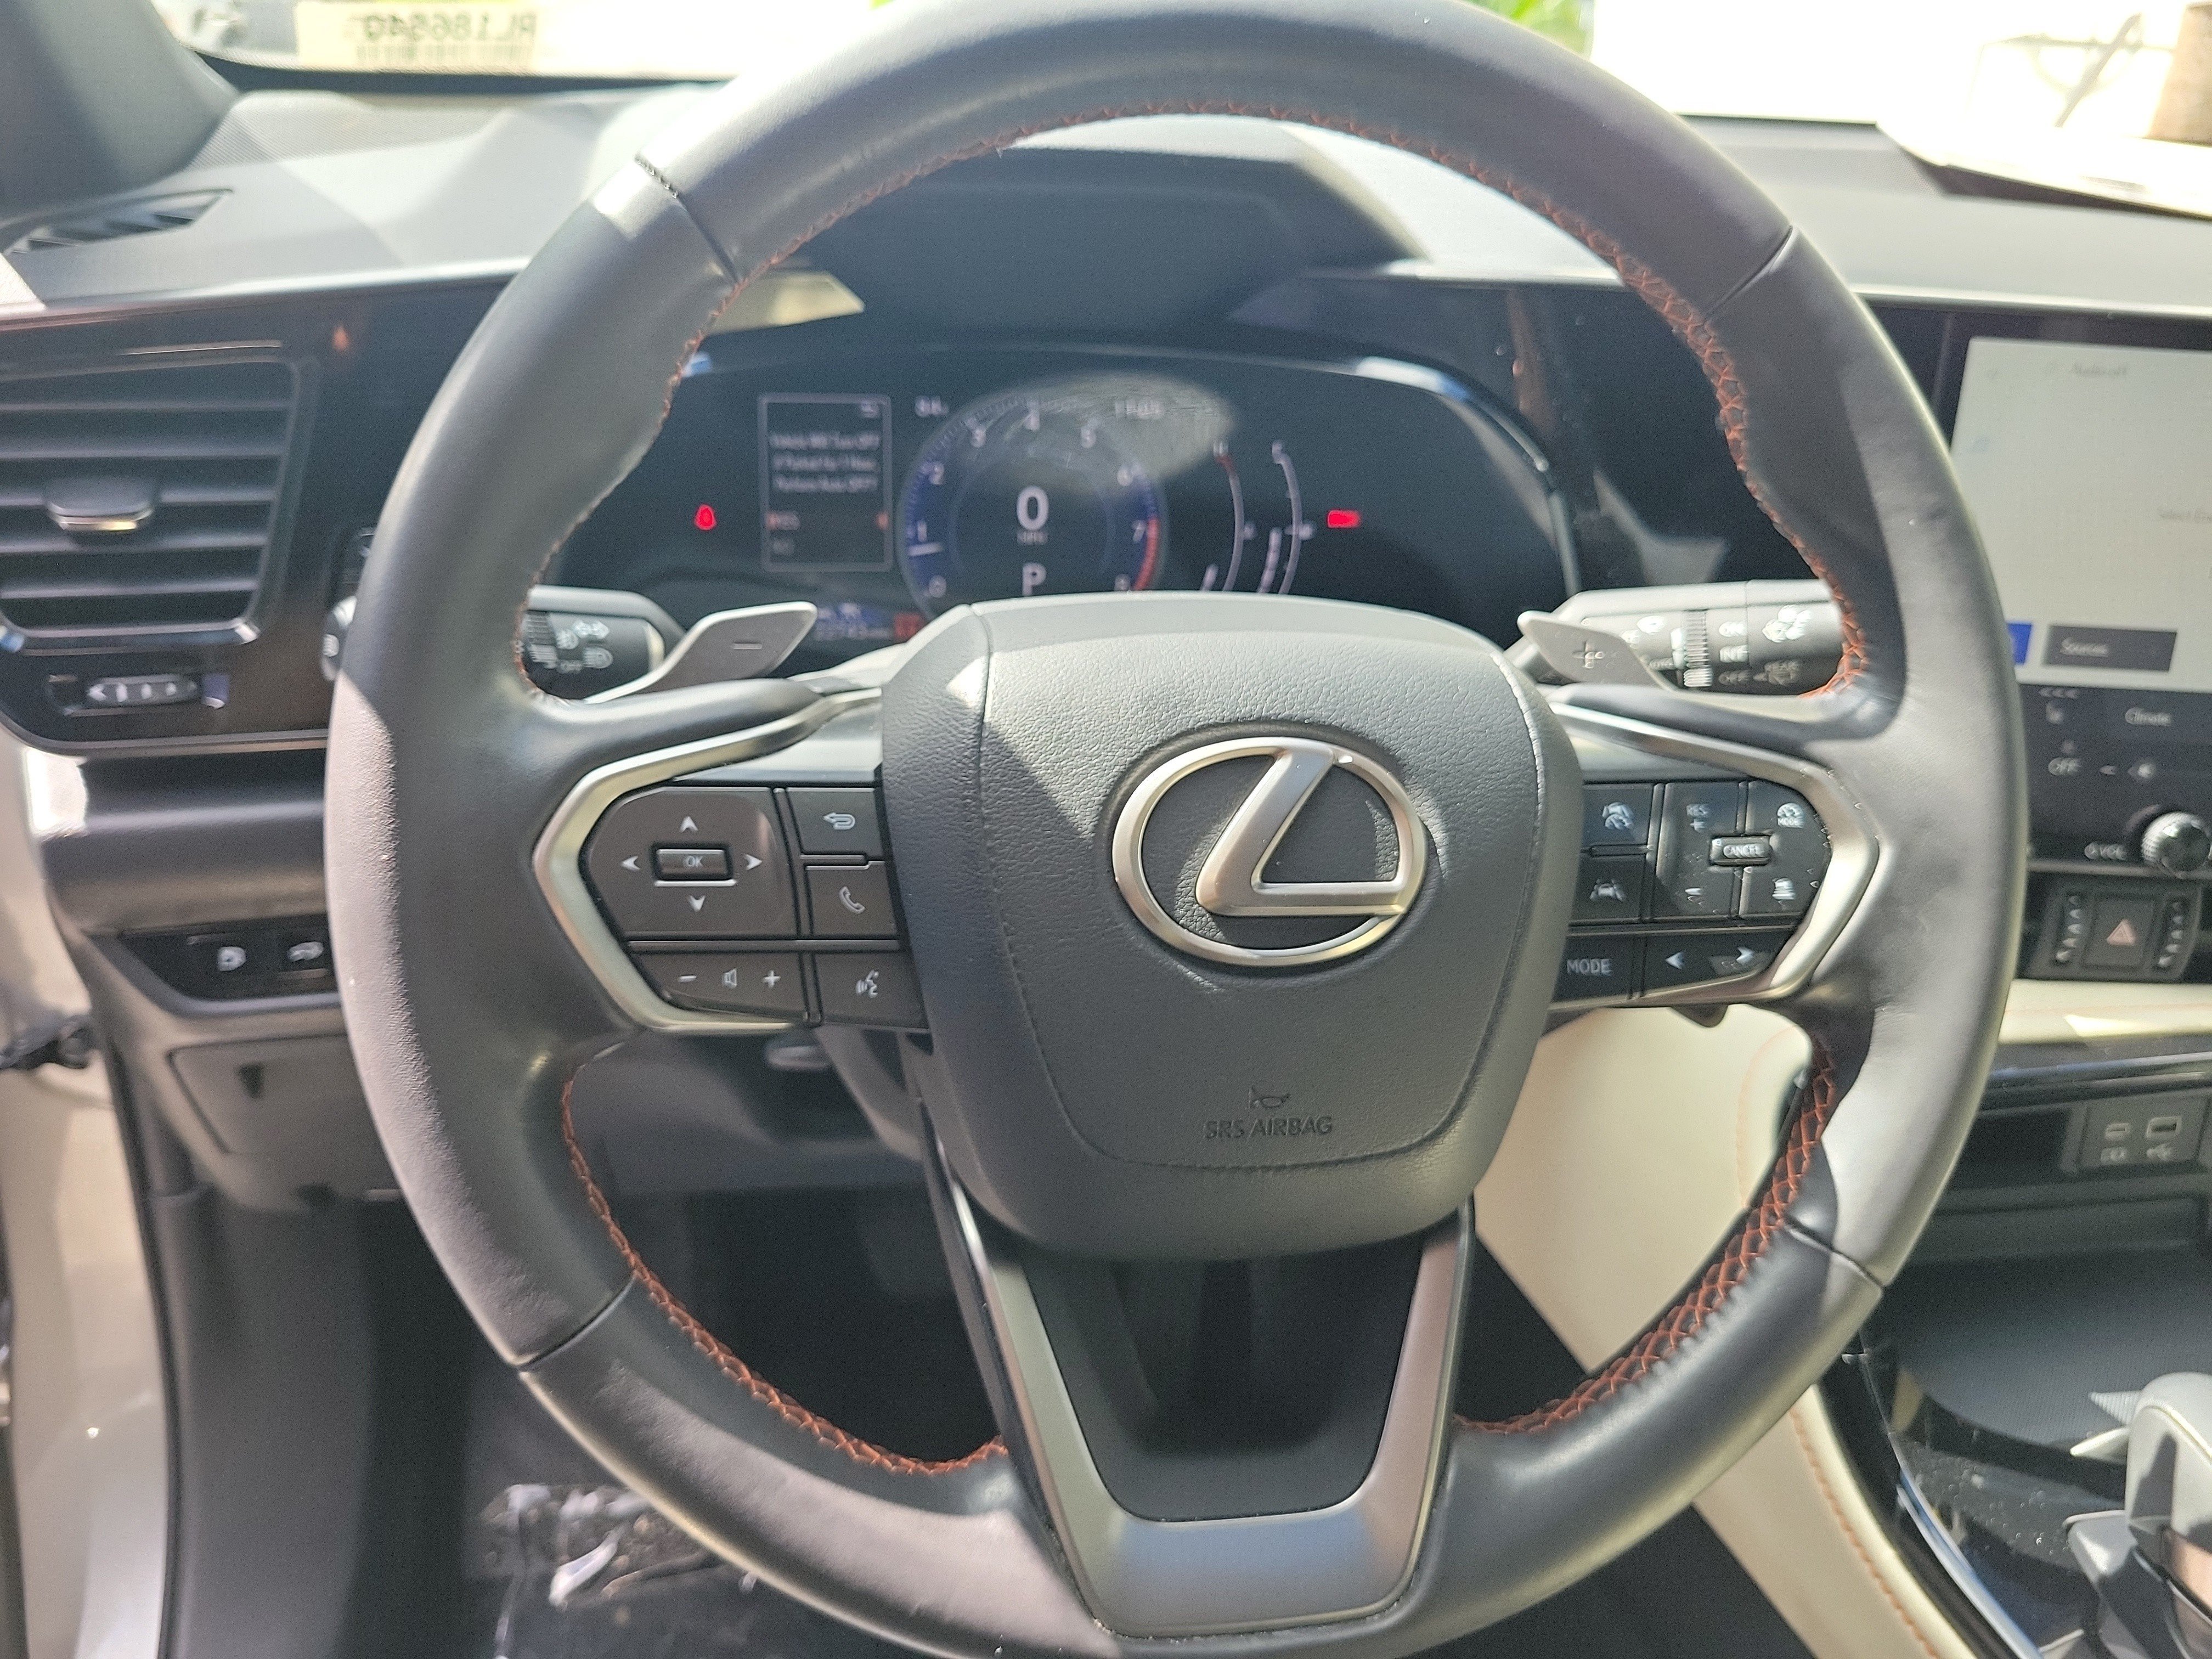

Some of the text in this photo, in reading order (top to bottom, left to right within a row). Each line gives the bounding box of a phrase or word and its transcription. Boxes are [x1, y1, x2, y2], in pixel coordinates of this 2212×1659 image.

[971, 426, 986, 448] 3
[1080, 425, 1096, 448] 5
[929, 461, 945, 484] 2
[1116, 464, 1134, 486] 6
[1016, 485, 1049, 531] 0
[1131, 521, 1145, 543] 7
[929, 575, 947, 599] 0
[1022, 562, 1047, 596] P
[683, 855, 704, 868] OK
[1723, 843, 1765, 859] CANCEL
[1566, 957, 1613, 977] MODE
[1203, 1115, 1334, 1140] SRS AIRBAG
